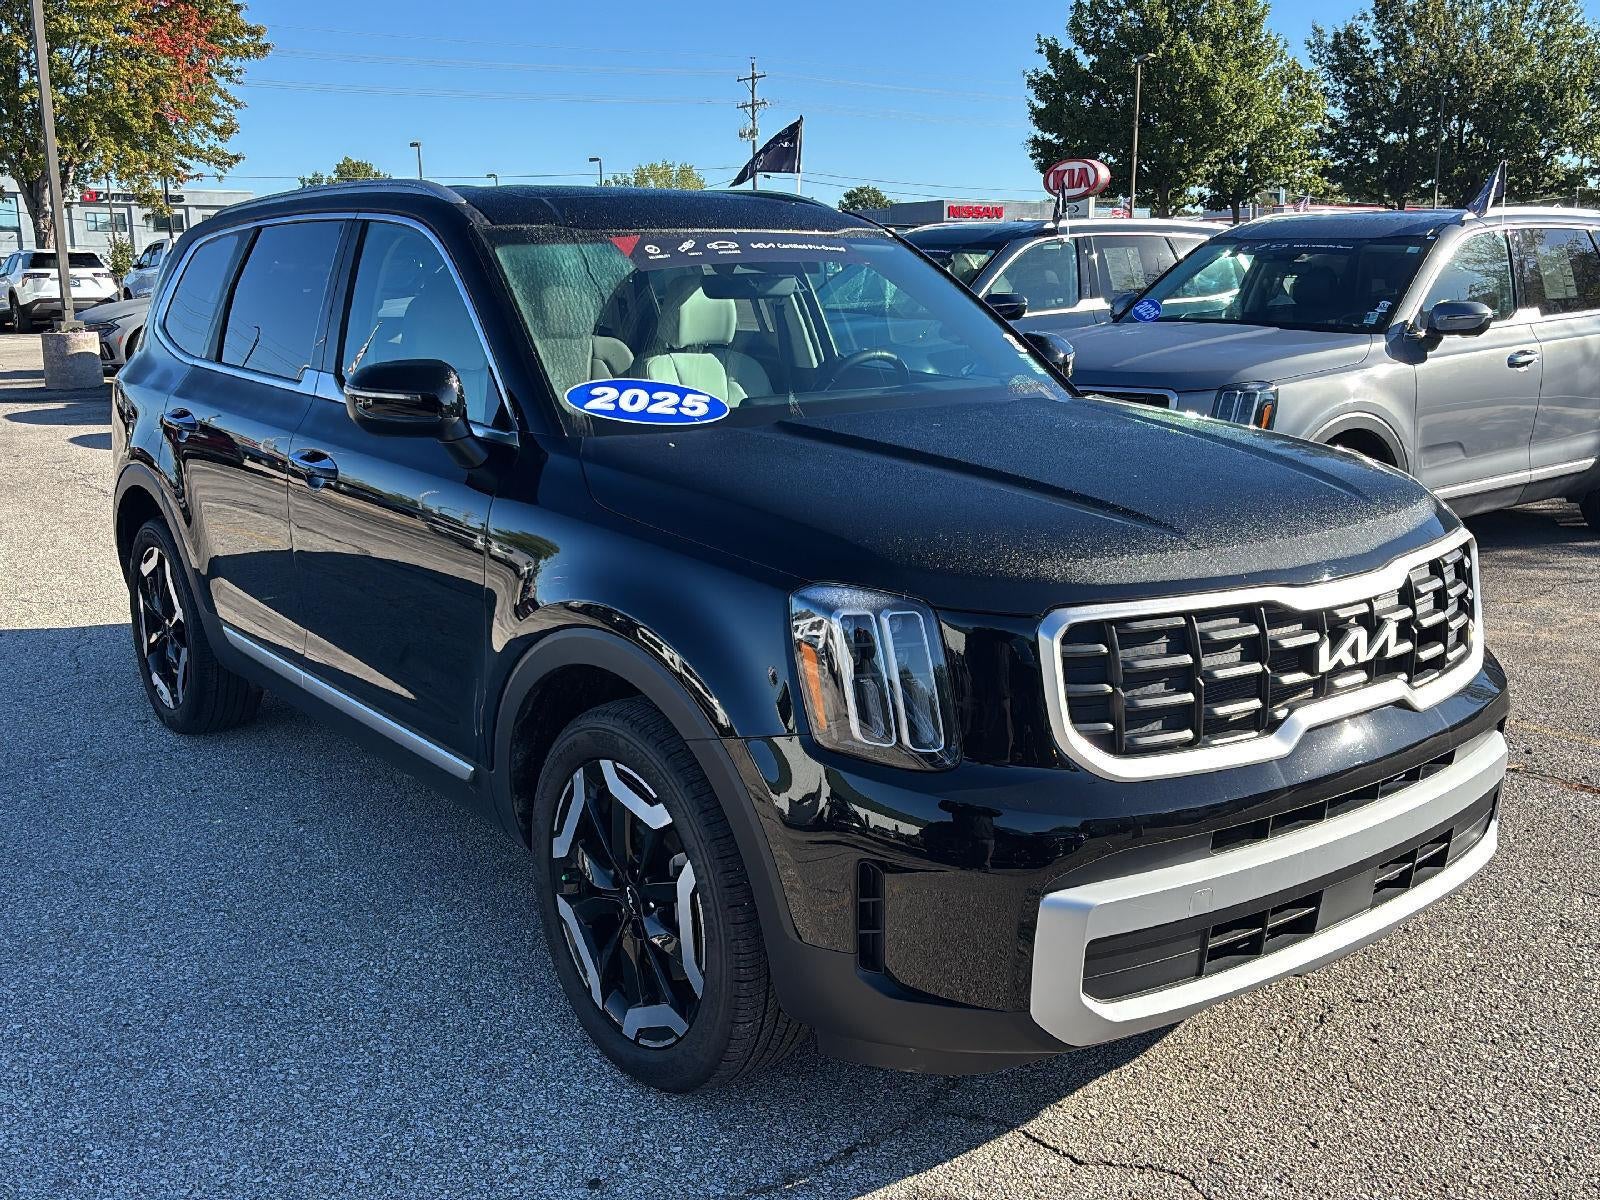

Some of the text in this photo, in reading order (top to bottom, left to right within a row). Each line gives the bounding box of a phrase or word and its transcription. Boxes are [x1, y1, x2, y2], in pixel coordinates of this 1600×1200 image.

[1052, 168, 1091, 190] KIA
[948, 204, 1004, 219] NISSAN
[1135, 301, 1160, 319] 2025
[583, 386, 711, 417] 2025
[1316, 618, 1400, 673] KIA
